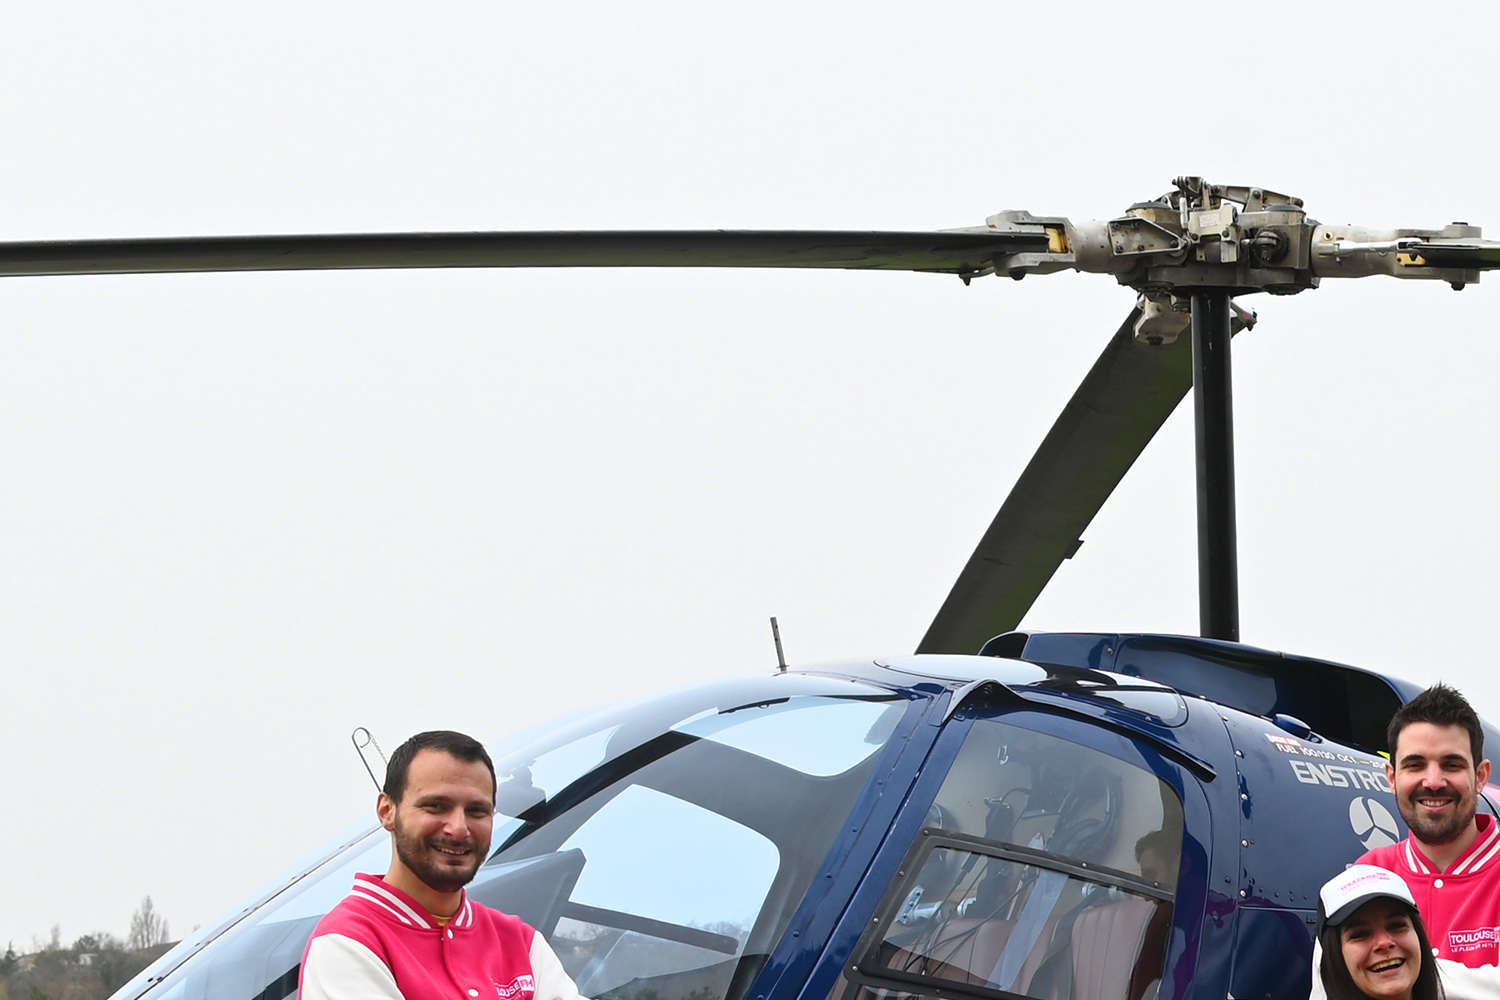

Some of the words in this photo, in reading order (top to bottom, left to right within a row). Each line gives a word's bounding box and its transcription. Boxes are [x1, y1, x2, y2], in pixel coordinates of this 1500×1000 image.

[1276, 743, 1299, 755] FUEL
[1289, 760, 1394, 793] ENSTRO
[1451, 930, 1495, 944] TOULOUSE
